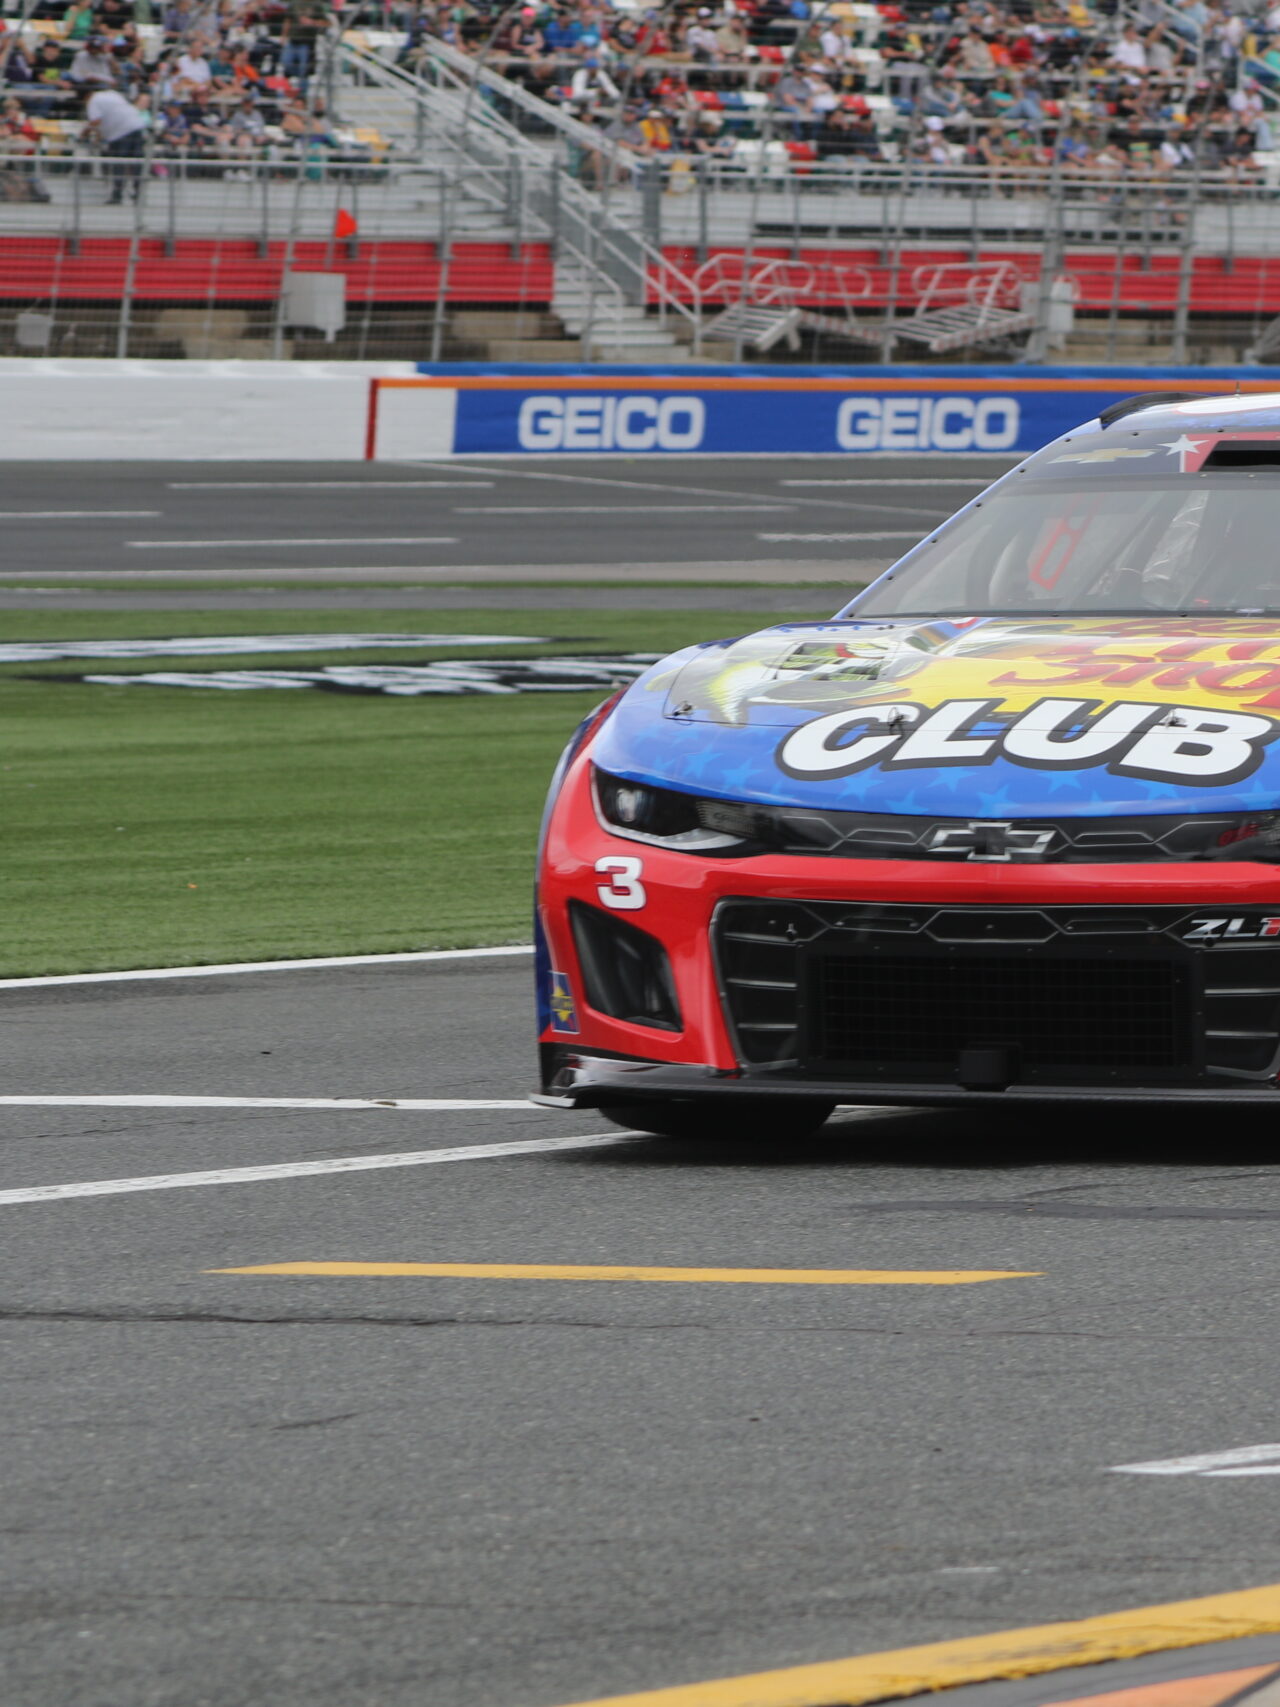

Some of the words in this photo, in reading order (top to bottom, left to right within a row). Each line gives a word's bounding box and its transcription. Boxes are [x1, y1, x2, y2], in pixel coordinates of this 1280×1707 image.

[518, 396, 706, 449] GEICO
[837, 397, 1020, 449] GEICO
[594, 855, 647, 911] 3
